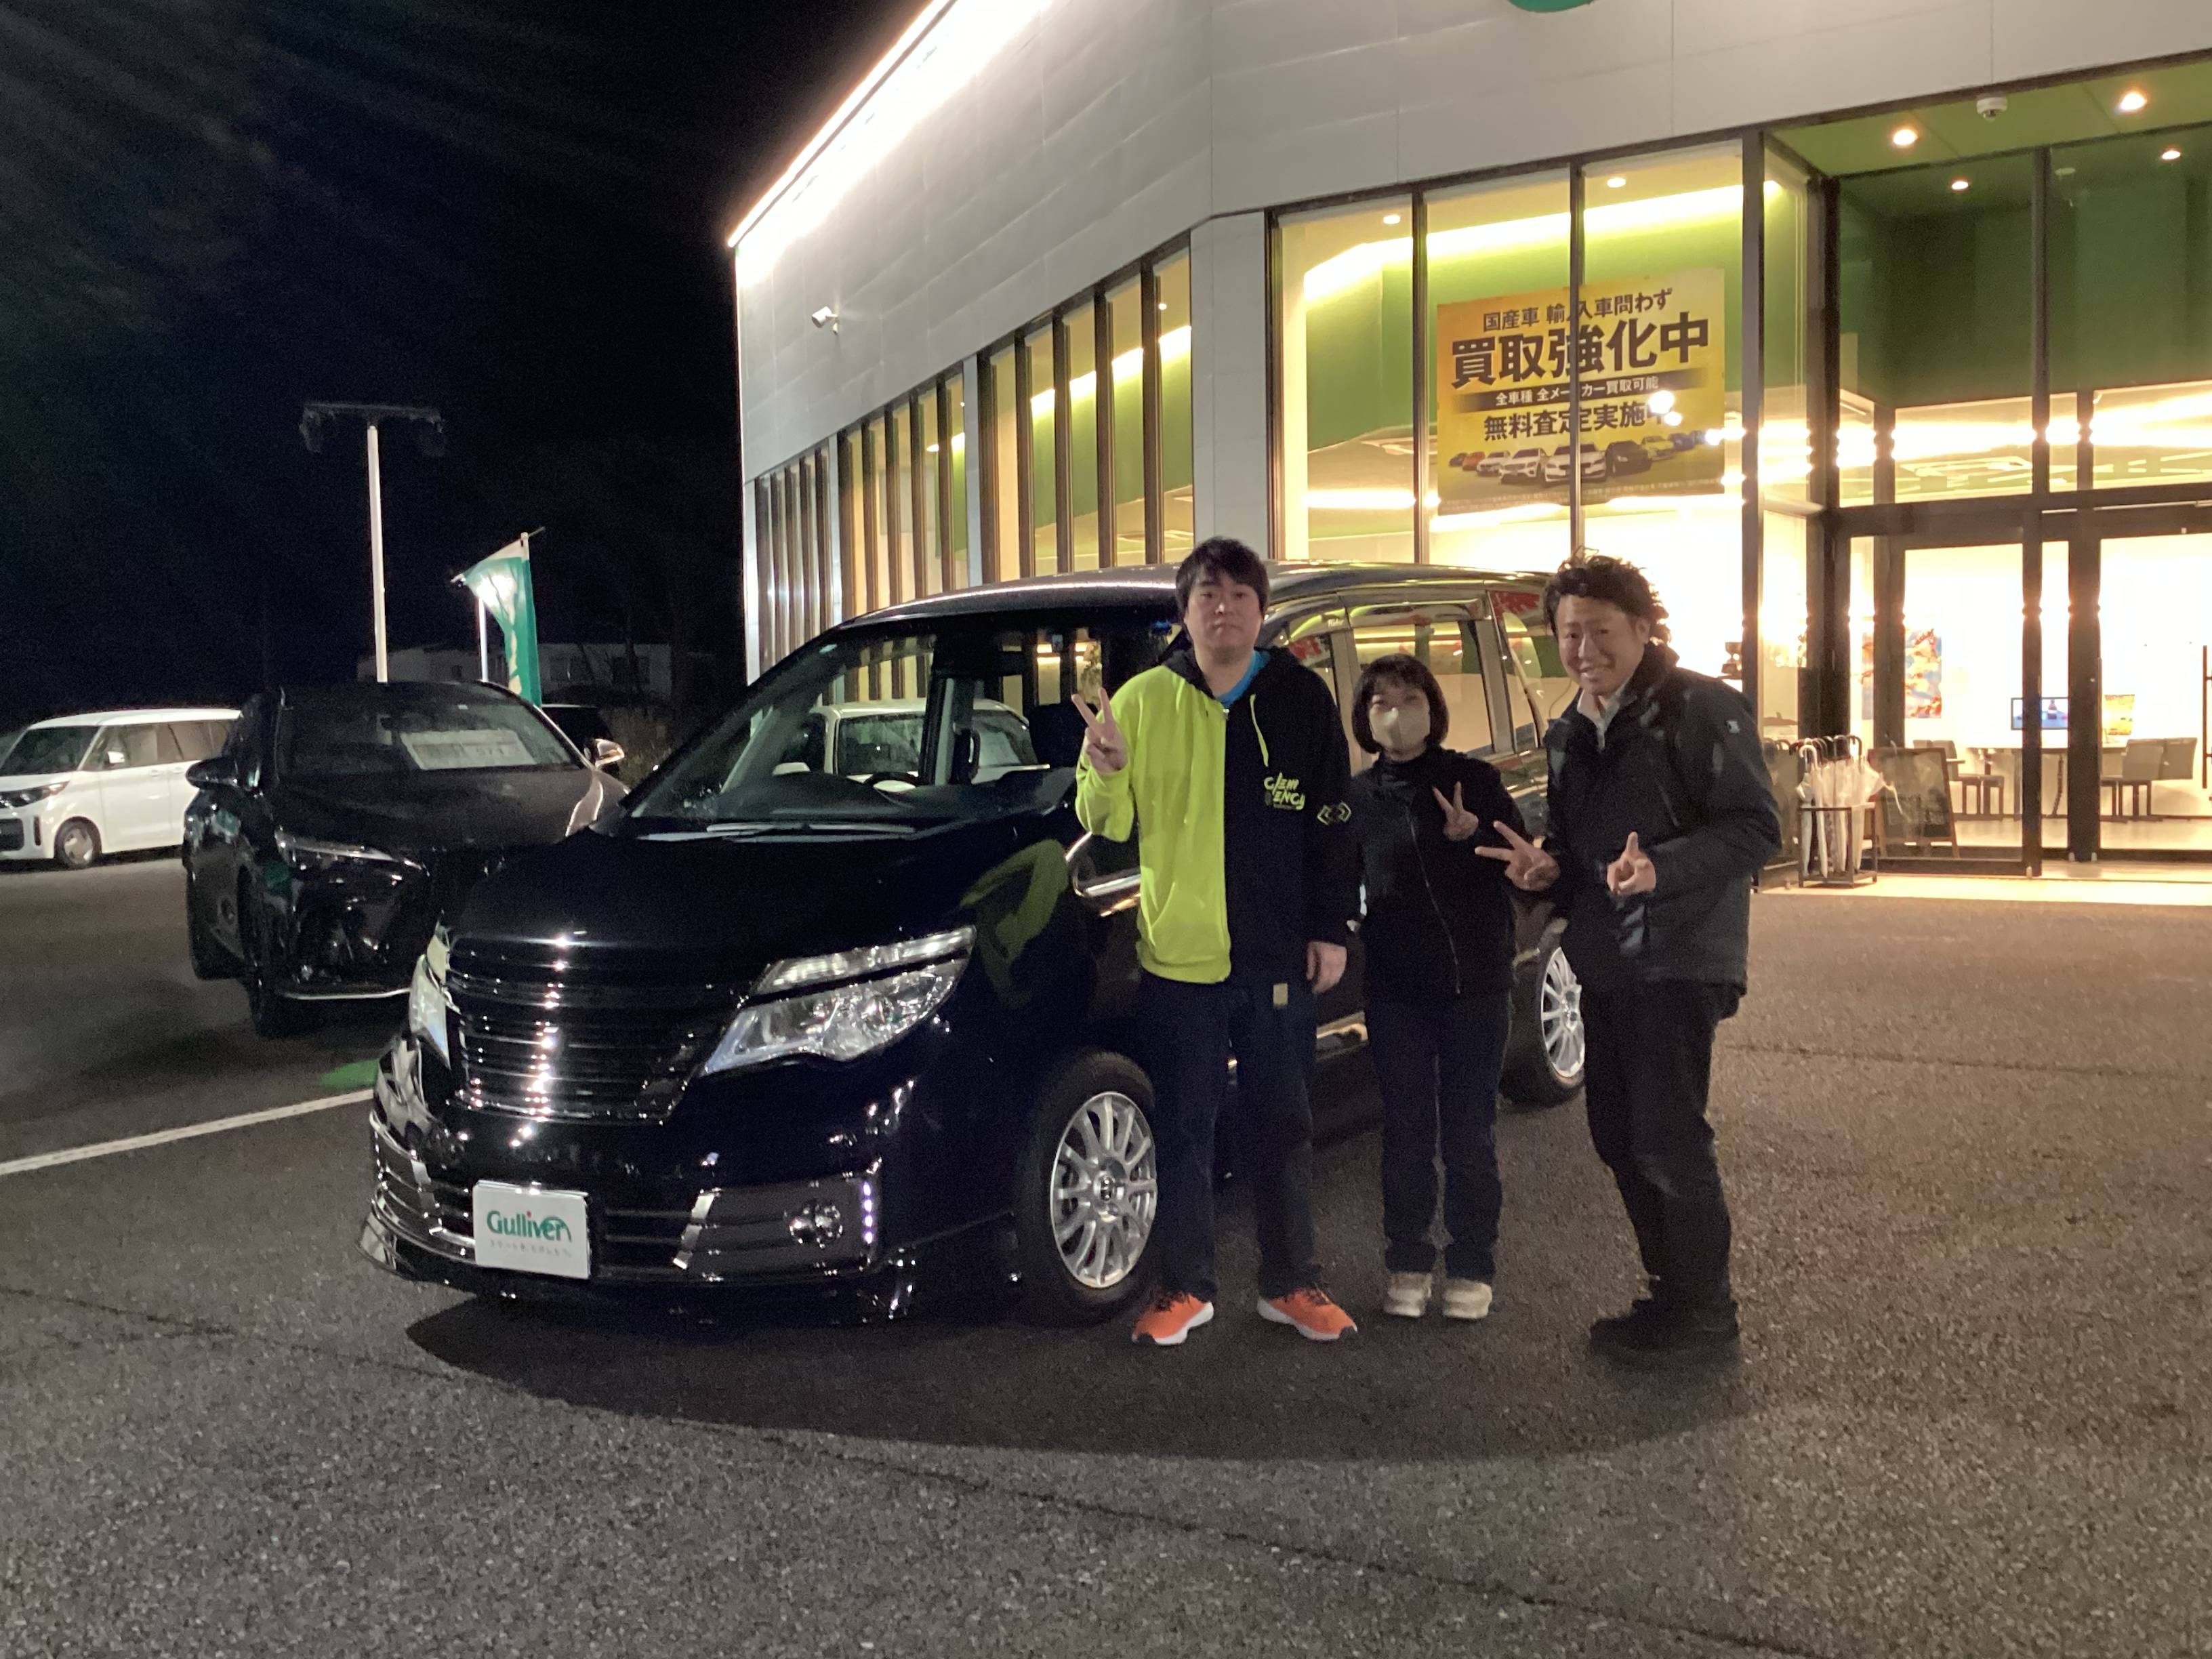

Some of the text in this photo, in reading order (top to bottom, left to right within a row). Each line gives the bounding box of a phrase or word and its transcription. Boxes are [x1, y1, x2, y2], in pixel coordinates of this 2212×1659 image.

[1483, 307, 1540, 332] 国産車
[1452, 311, 1708, 388] 買取強化中
[1496, 390, 1533, 407] 全車種
[487, 1210, 572, 1242] Gulliver
